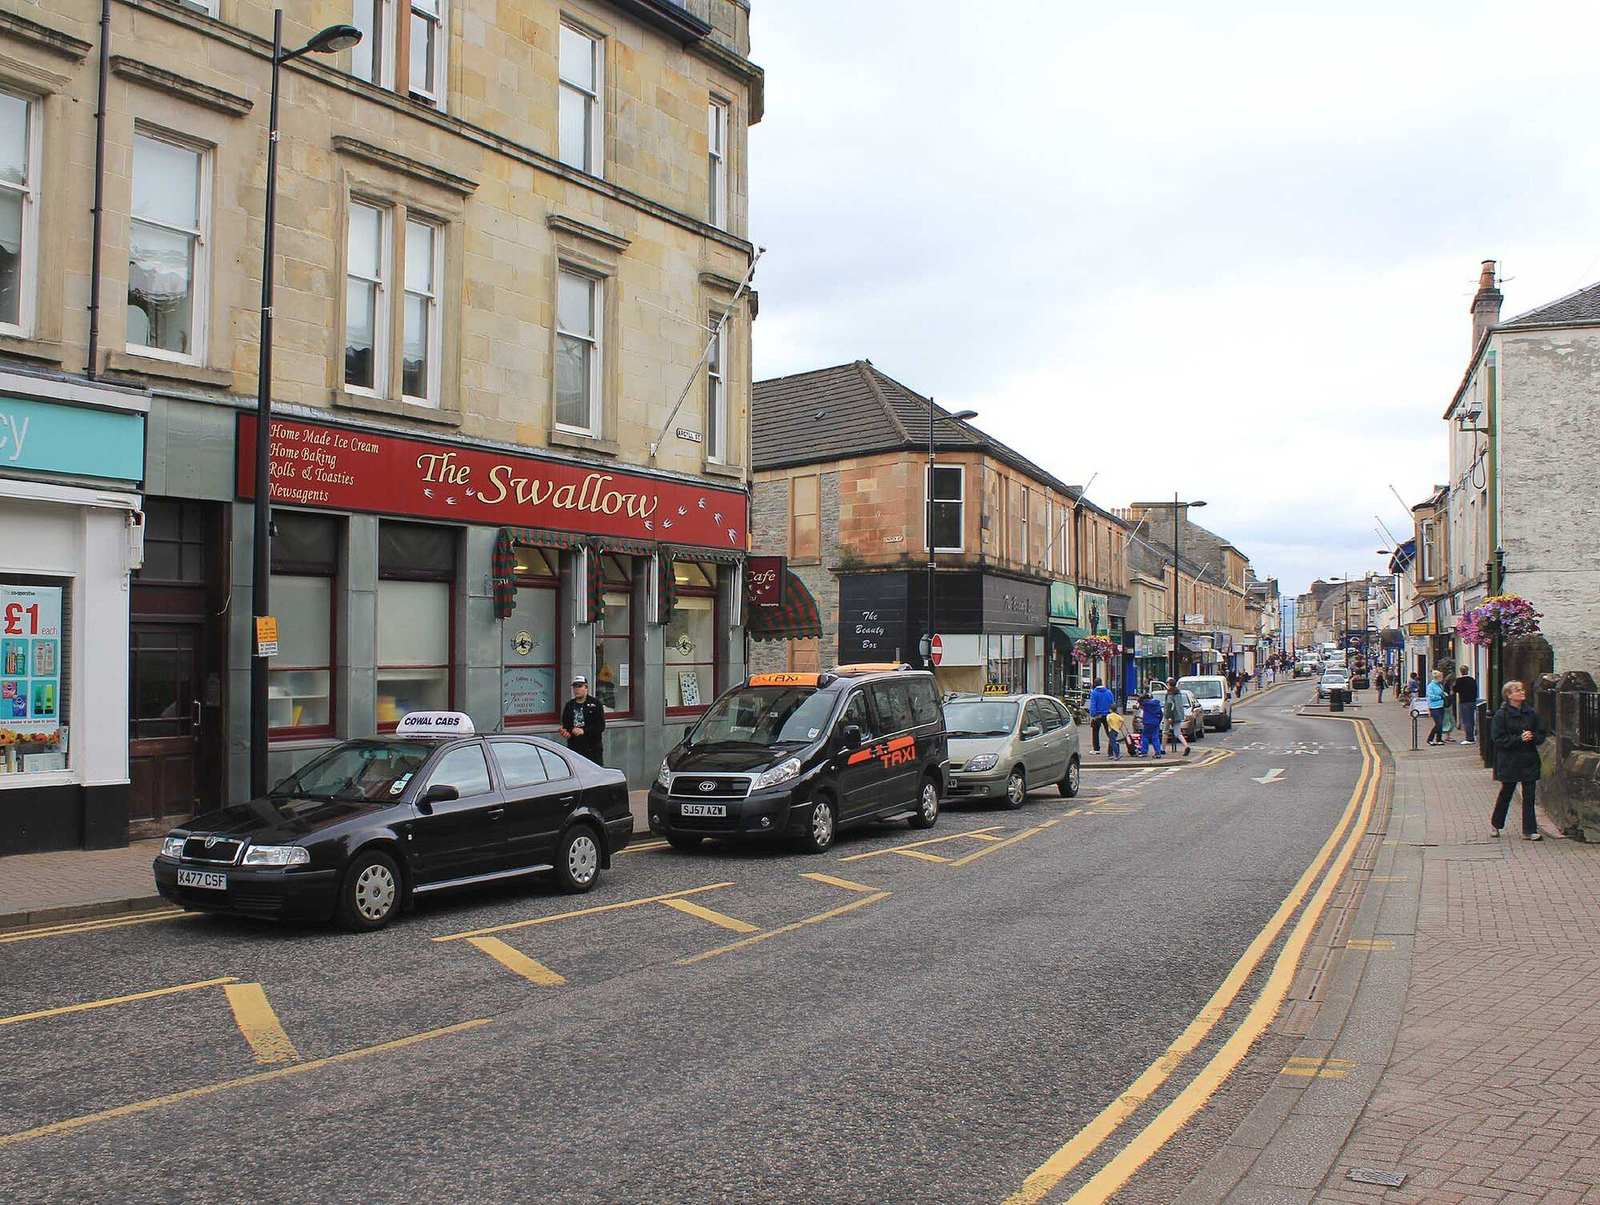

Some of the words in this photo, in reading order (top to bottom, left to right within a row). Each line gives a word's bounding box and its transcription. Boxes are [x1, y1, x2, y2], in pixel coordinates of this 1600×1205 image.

[269, 424, 300, 441] Home
[303, 429, 331, 446] Made
[334, 434, 348, 449] Ice
[351, 437, 380, 453] Cream
[269, 443, 299, 459] Home
[301, 448, 337, 469] Baking
[269, 461, 296, 478] Rolls
[302, 465, 313, 480] &
[315, 468, 355, 485] Toasties
[268, 482, 329, 504] Newsagents
[416, 452, 471, 485] The
[477, 465, 658, 519] Swallow
[4, 603, 39, 635] £1
[862, 611, 878, 621] The
[855, 624, 885, 636] Beauty
[862, 639, 878, 649] Box
[768, 674, 800, 682] TAXI
[984, 684, 1008, 692] TAXI
[404, 717, 433, 726] COWAL
[435, 717, 460, 726] CABS
[880, 744, 917, 769] TAXI
[204, 873, 225, 887] CSF
